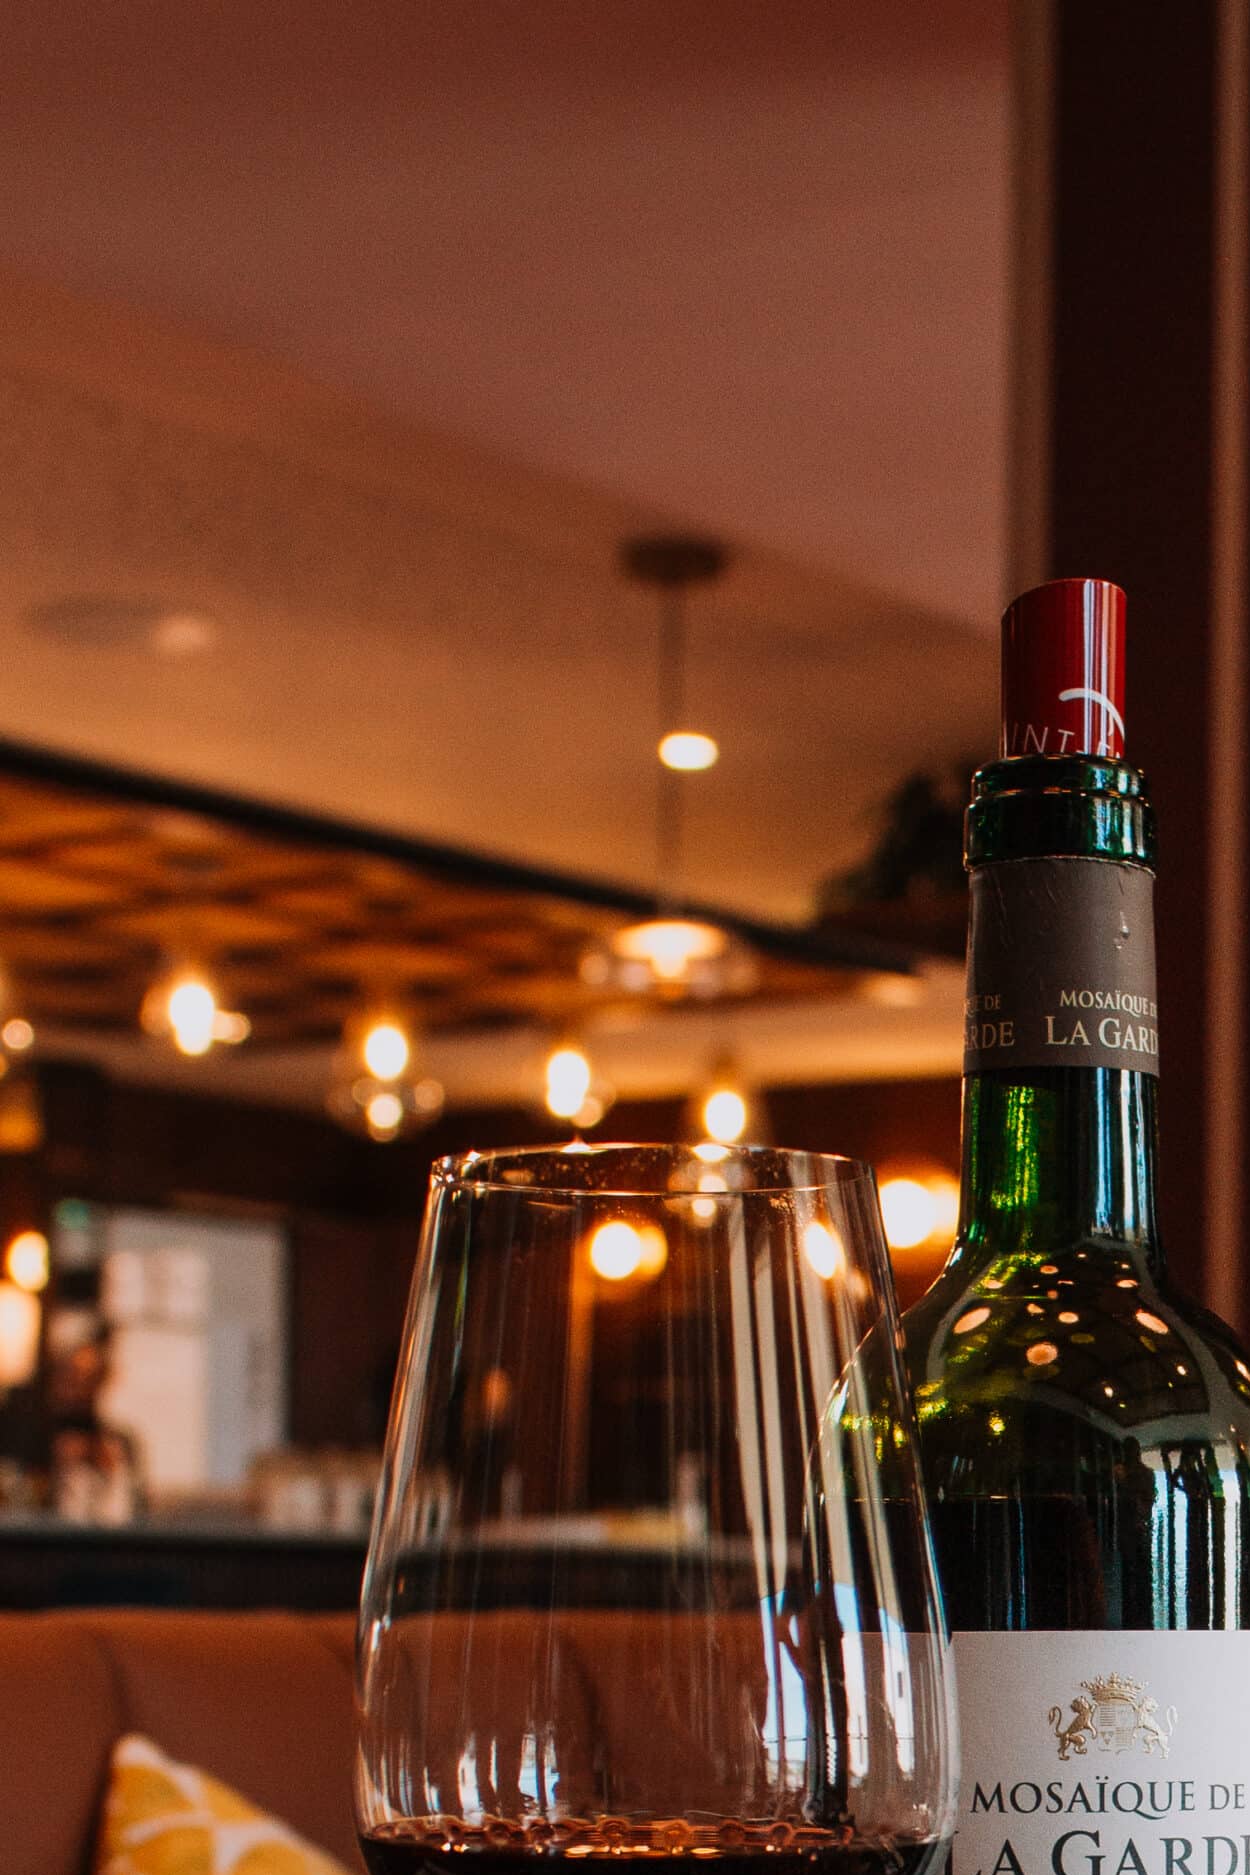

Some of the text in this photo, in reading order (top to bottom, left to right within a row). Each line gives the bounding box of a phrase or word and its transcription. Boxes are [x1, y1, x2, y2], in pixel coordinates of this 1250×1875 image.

[1060, 989, 1148, 1018] MOSAÏQUE
[966, 1021, 1015, 1050] RDE
[1044, 1015, 1159, 1055] LA GARD
[969, 1775, 1246, 1820] MOSAÏQUE DE
